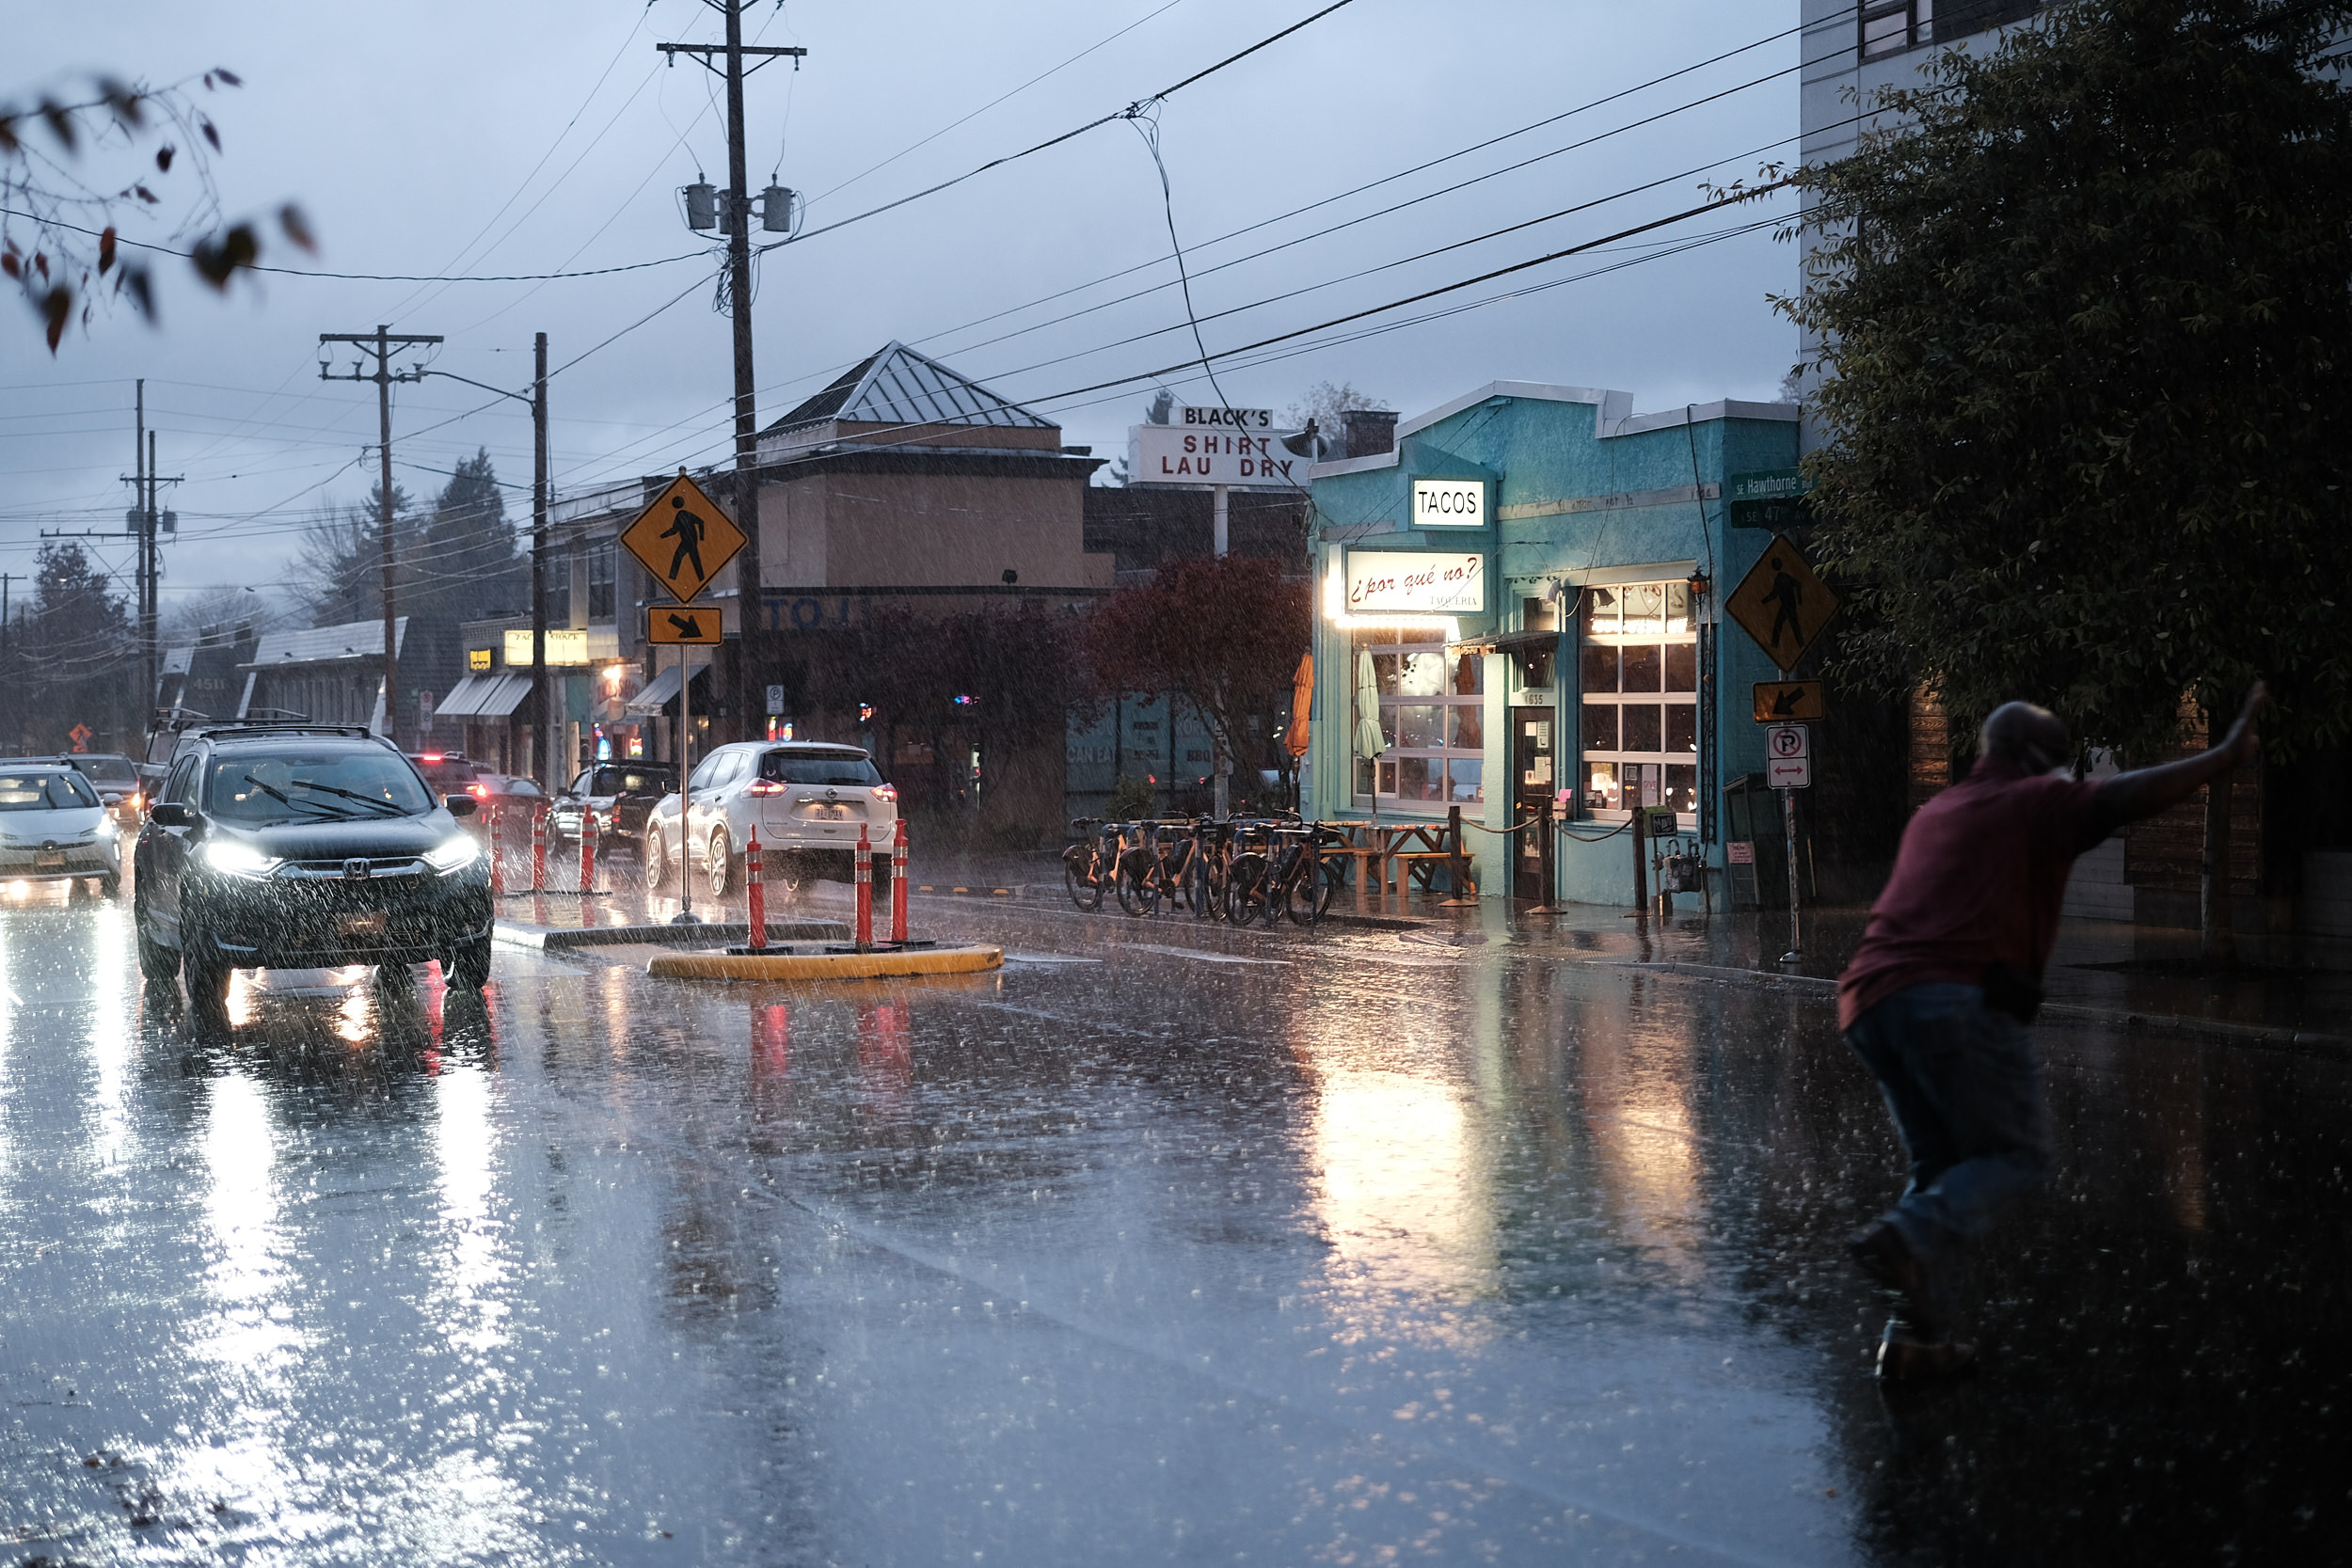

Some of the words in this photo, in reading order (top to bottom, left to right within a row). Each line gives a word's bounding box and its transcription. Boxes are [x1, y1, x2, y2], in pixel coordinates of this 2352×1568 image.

[1185, 407, 1269, 426] BLACK'S
[1184, 435, 1271, 455] SHIRT
[1162, 455, 1212, 475] LAU
[1240, 458, 1294, 478] DRY
[1737, 483, 1744, 495] SE
[1747, 475, 1796, 494] Hawthorne
[1418, 491, 1476, 515] TACOS
[1746, 511, 1758, 522] SE
[1351, 578, 1395, 604] ¿por
[1404, 564, 1437, 596] qué
[1444, 557, 1478, 582] no?
[1431, 595, 1477, 608] TAQUERIA
[1066, 747, 1093, 763] CAN
[1187, 750, 1211, 763] BBQ
